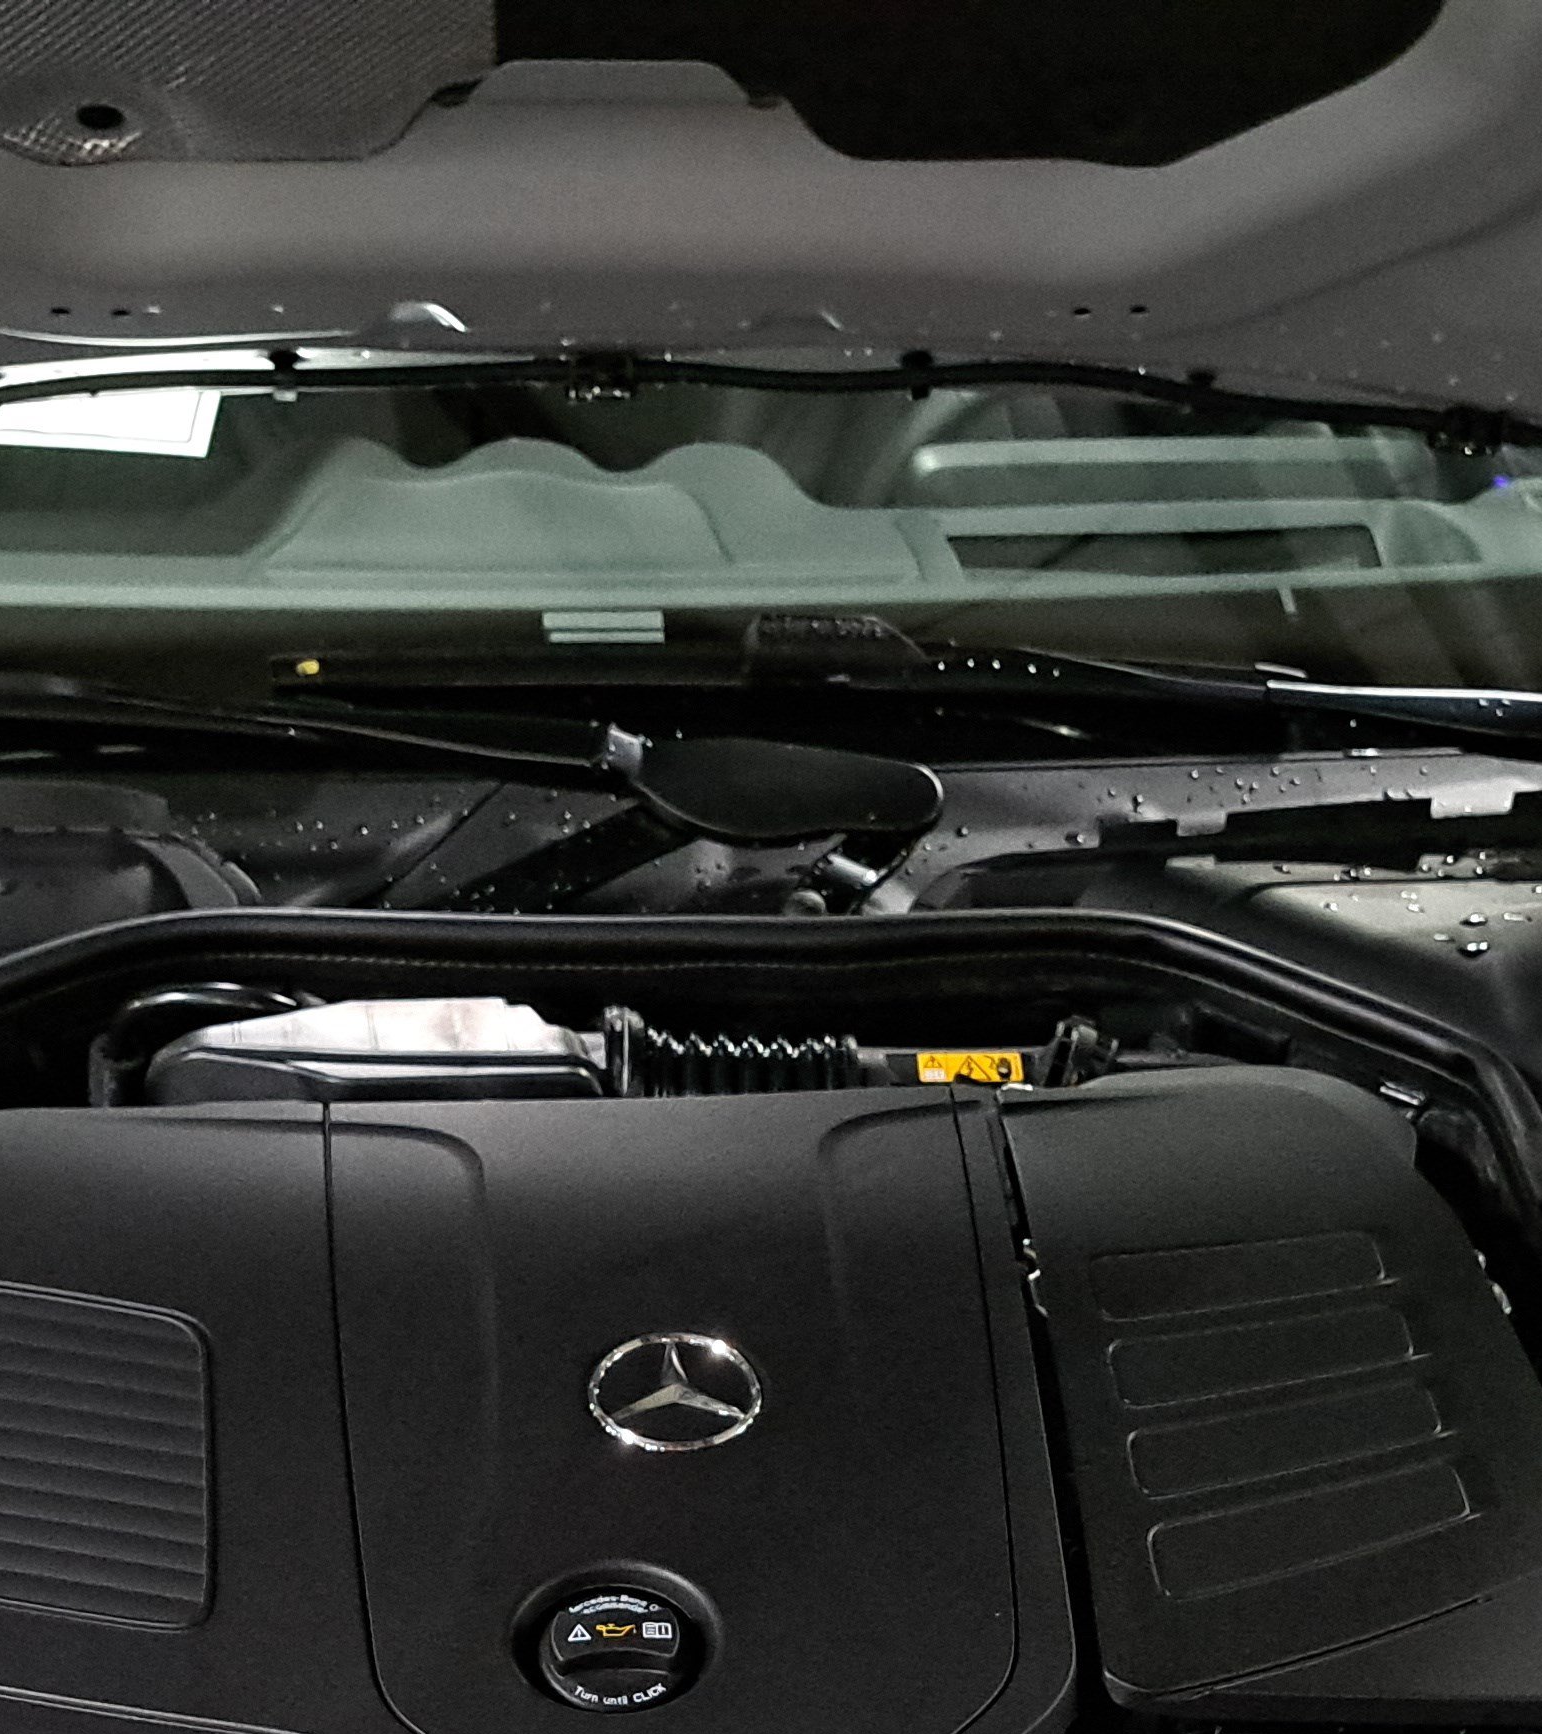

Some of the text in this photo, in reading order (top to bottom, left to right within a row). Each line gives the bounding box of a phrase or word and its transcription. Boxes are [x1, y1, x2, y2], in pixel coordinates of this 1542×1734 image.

[574, 1682, 667, 1705] Turn until CLICK
